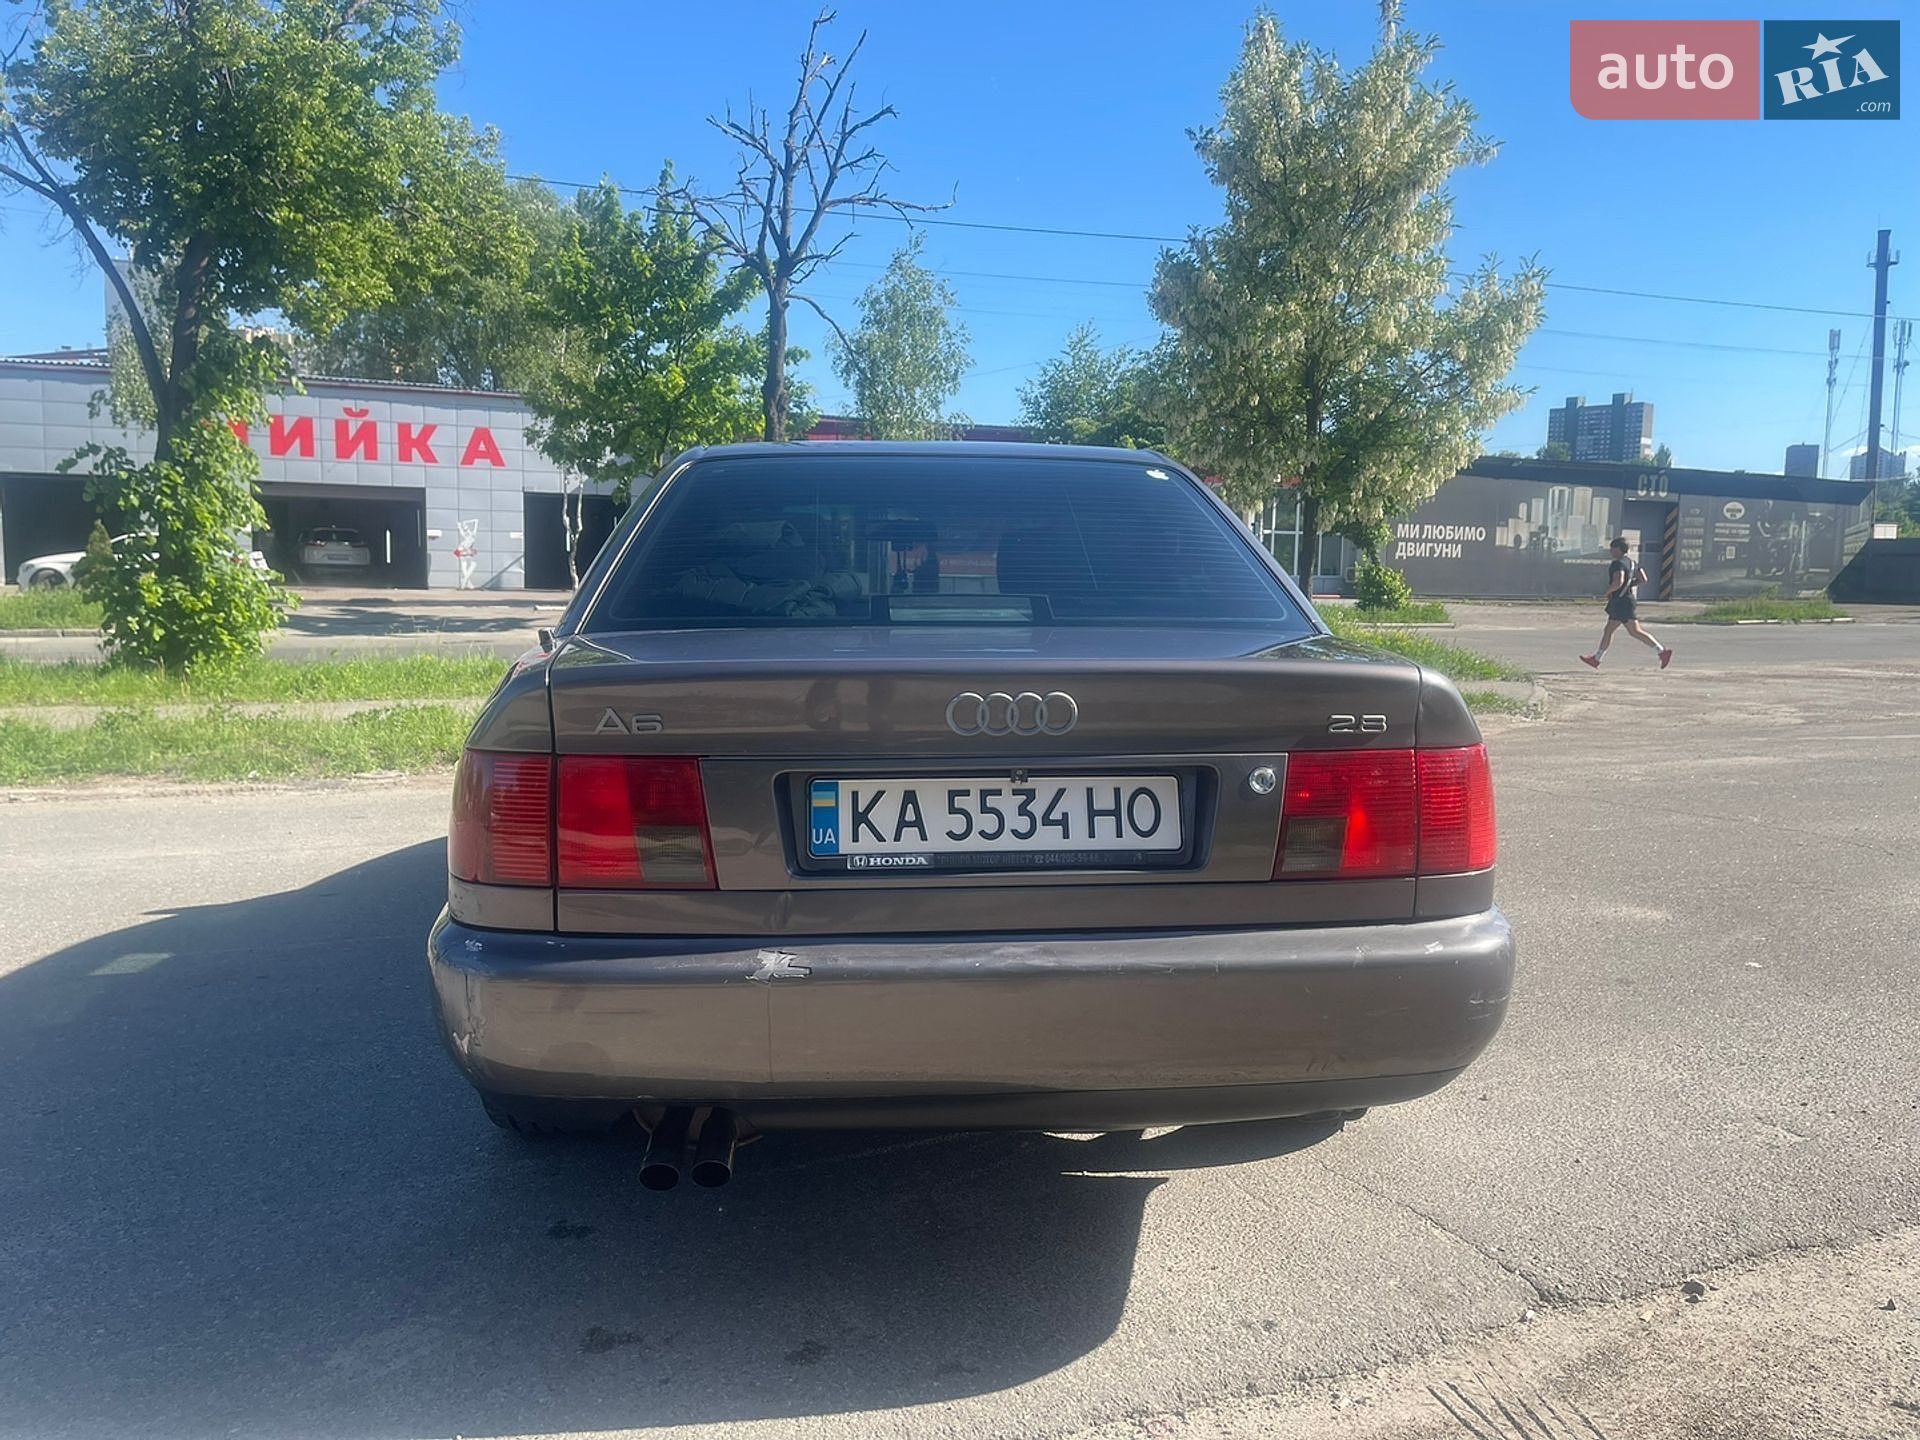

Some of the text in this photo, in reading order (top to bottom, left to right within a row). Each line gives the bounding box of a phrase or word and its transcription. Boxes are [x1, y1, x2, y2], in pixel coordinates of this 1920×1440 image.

[1397, 523, 1487, 541] МИ ЛЮБИМО
[1395, 541, 1462, 559] ДВИГУНИ
[593, 706, 664, 735] A6
[850, 786, 1162, 843] KA 5534 HO
[811, 828, 837, 845] UA
[868, 856, 929, 867] HONDA
